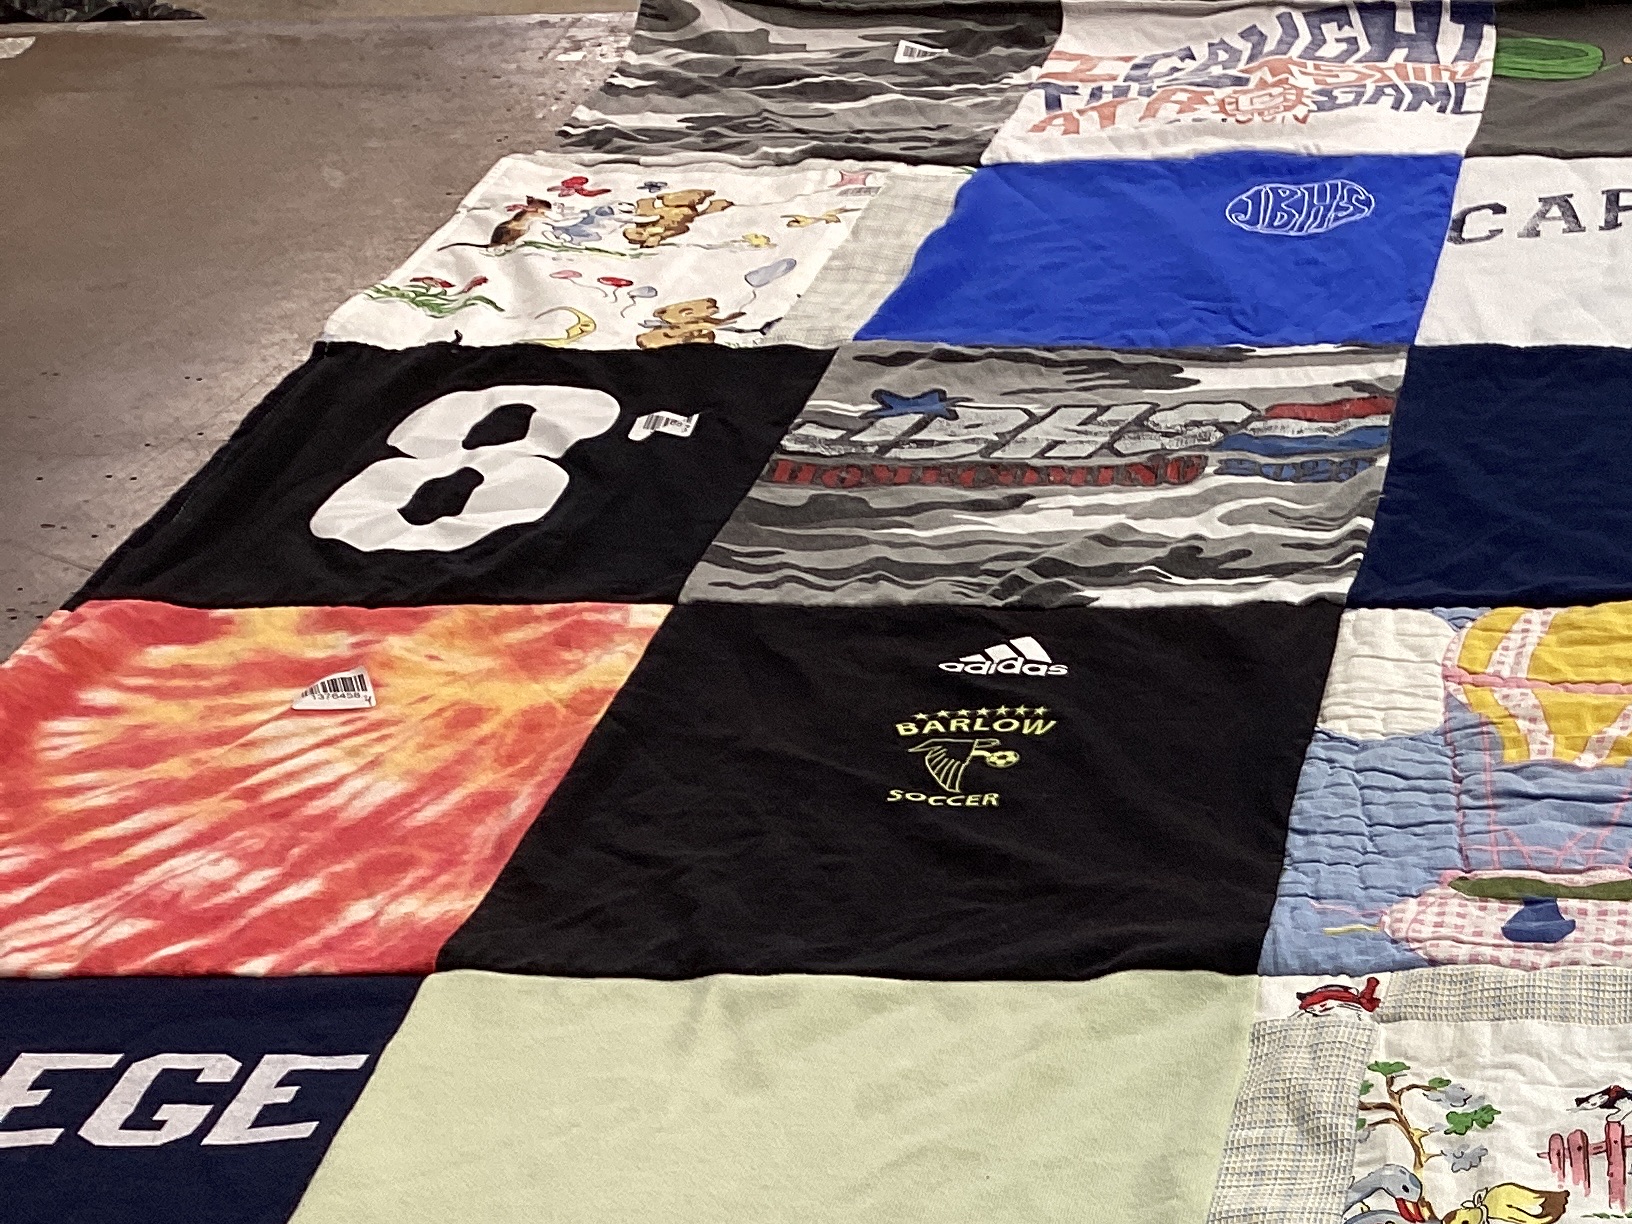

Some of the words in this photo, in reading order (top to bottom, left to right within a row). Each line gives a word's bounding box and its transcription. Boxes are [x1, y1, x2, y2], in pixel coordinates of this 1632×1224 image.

[1123, 2, 1495, 82] CAUGHT
[309, 385, 621, 553] 8
[938, 657, 1069, 676] adidas
[895, 718, 1057, 737] BARLOW
[887, 789, 999, 807] SOCCER
